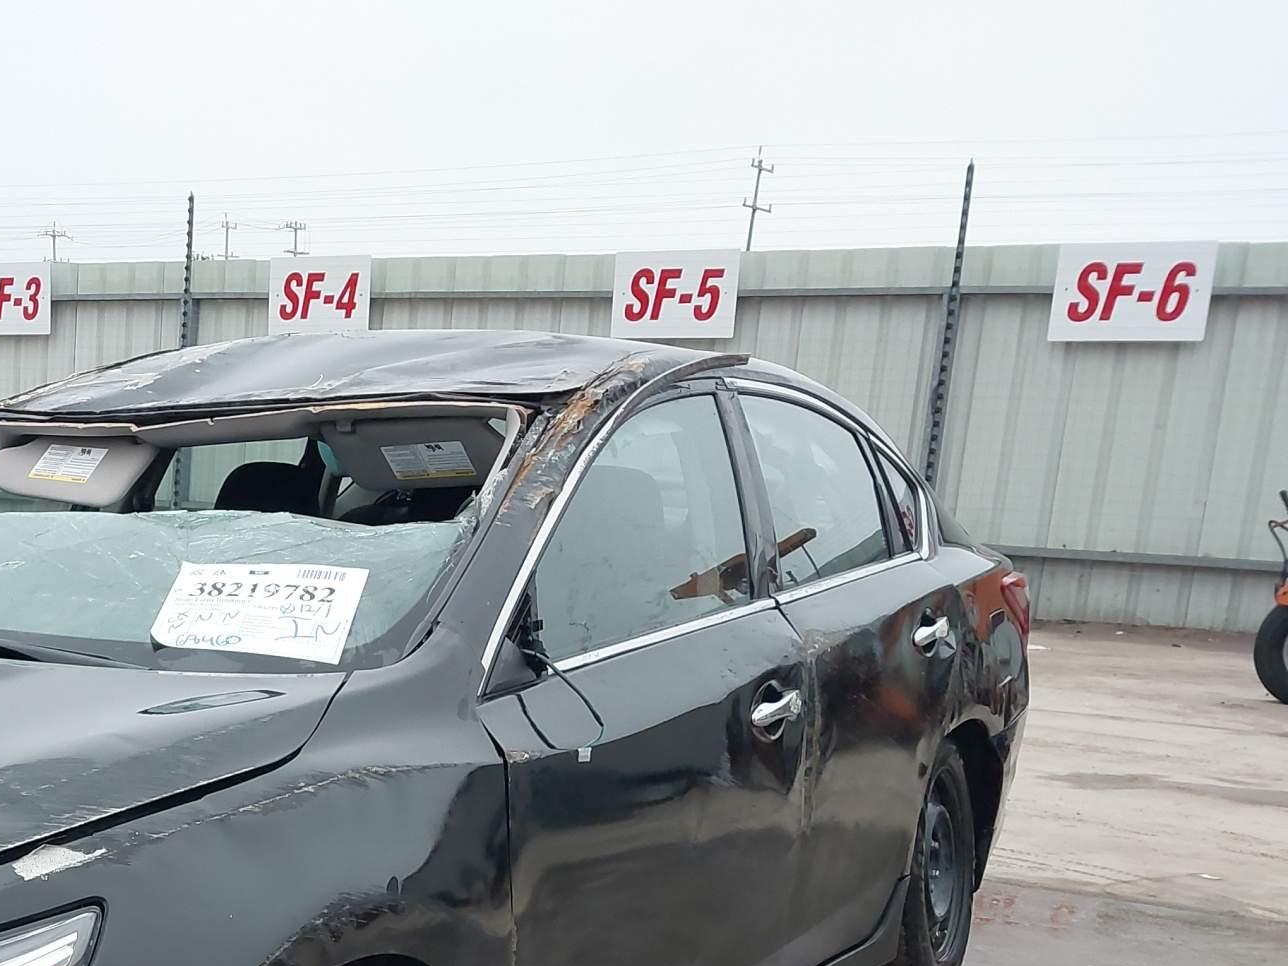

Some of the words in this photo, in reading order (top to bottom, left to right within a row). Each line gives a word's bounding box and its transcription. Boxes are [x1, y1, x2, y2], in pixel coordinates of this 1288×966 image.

[280, 272, 359, 321] SF-4
[625, 268, 724, 321] SF-5
[1068, 262, 1196, 322] SF-6
[188, 581, 336, 604] 38219782
